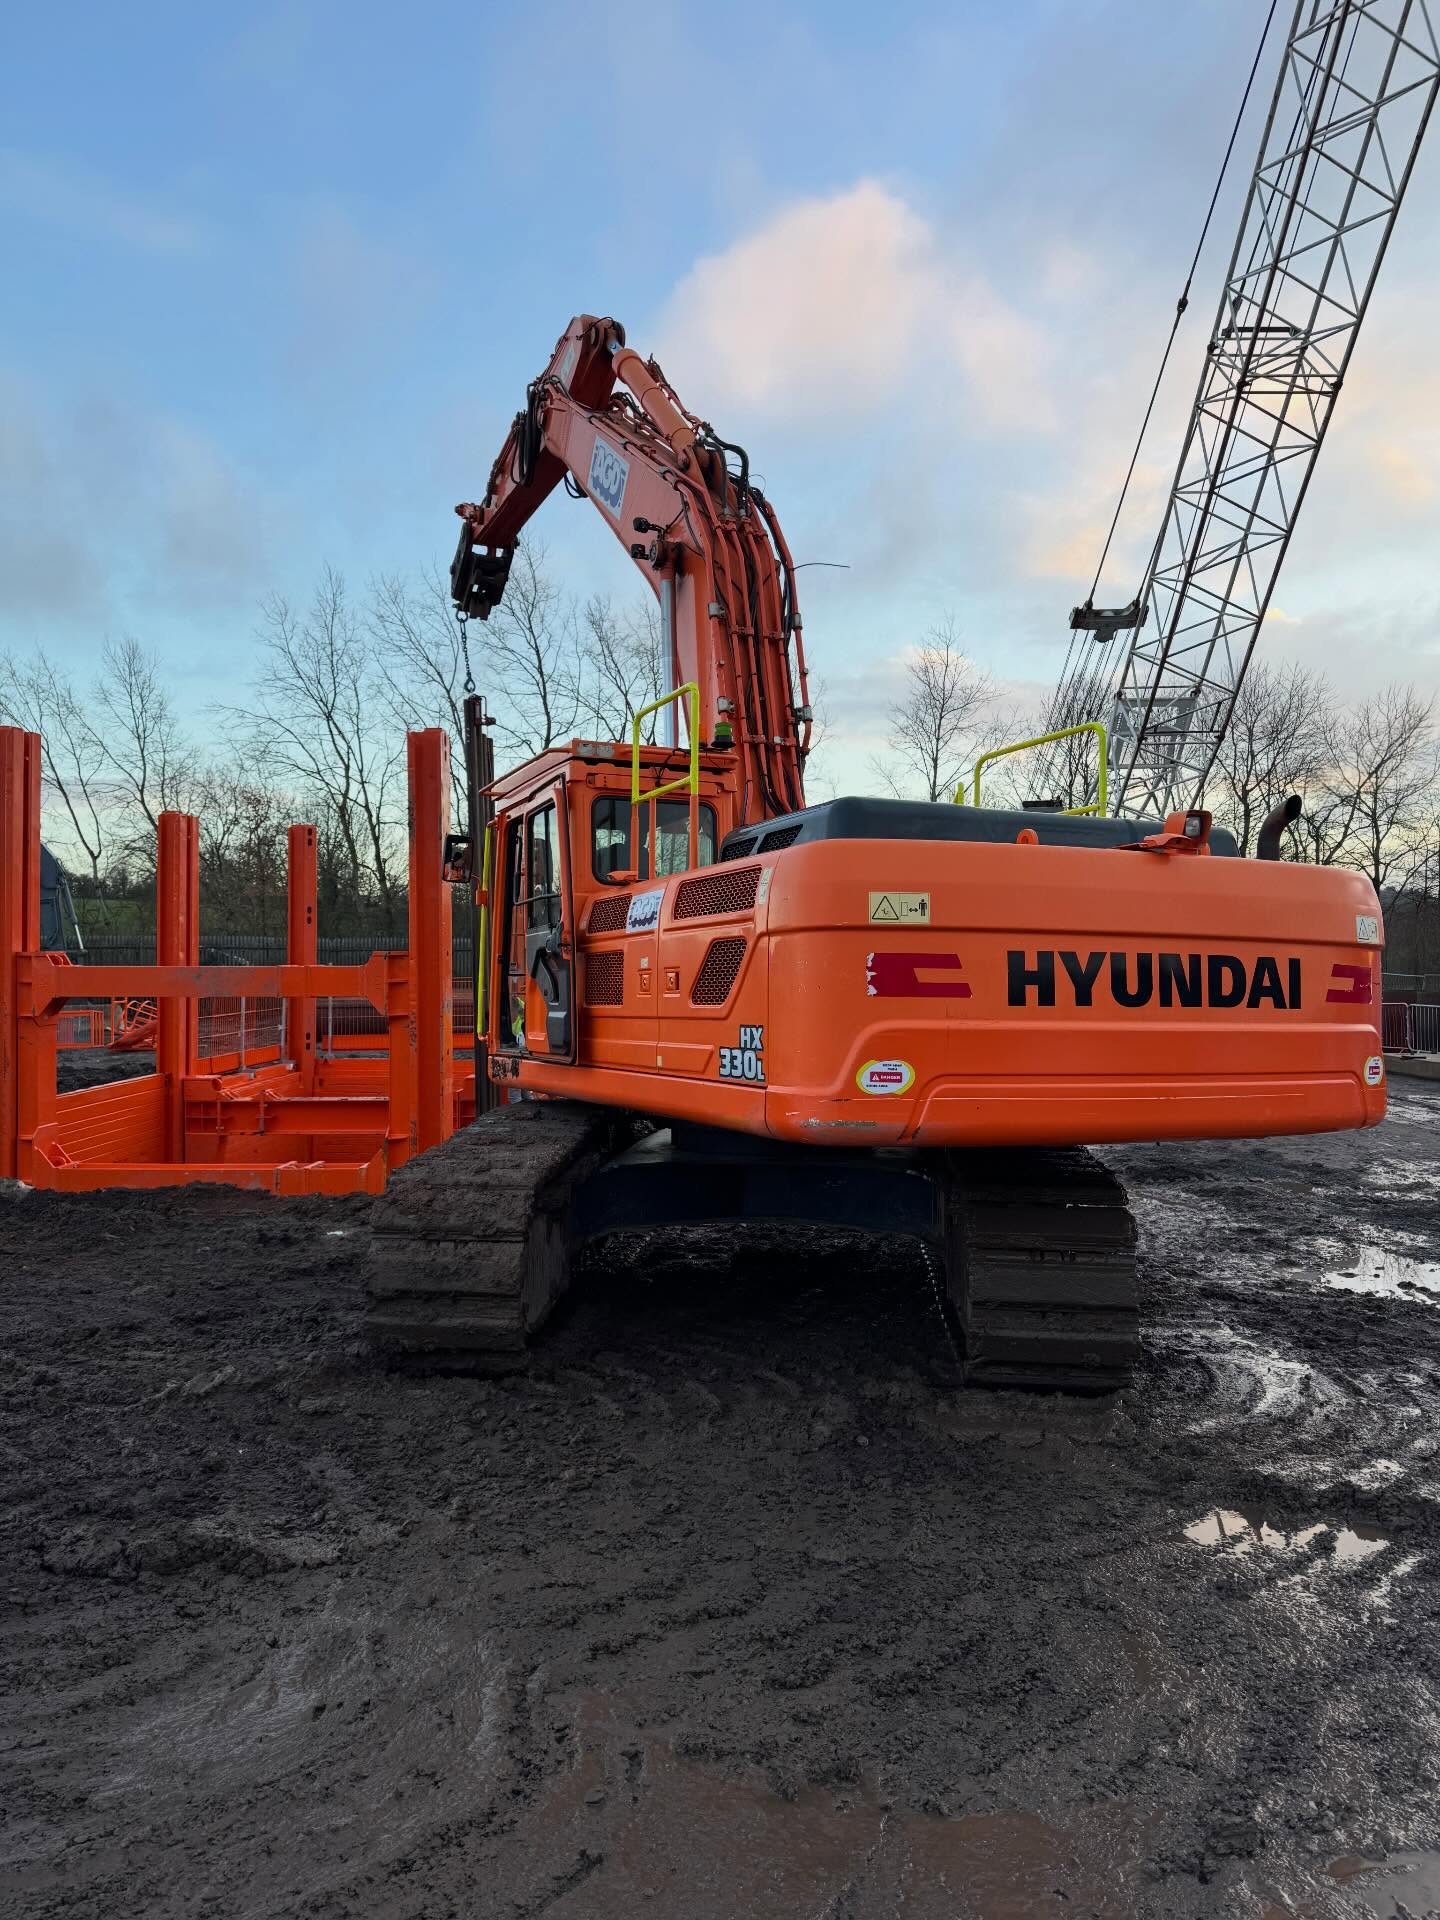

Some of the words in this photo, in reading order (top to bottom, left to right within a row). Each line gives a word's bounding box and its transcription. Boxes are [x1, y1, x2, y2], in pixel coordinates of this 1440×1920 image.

[1007, 950, 1302, 1009] HYUNDAI
[740, 1026, 763, 1050] HX
[719, 1048, 766, 1081] 330L
